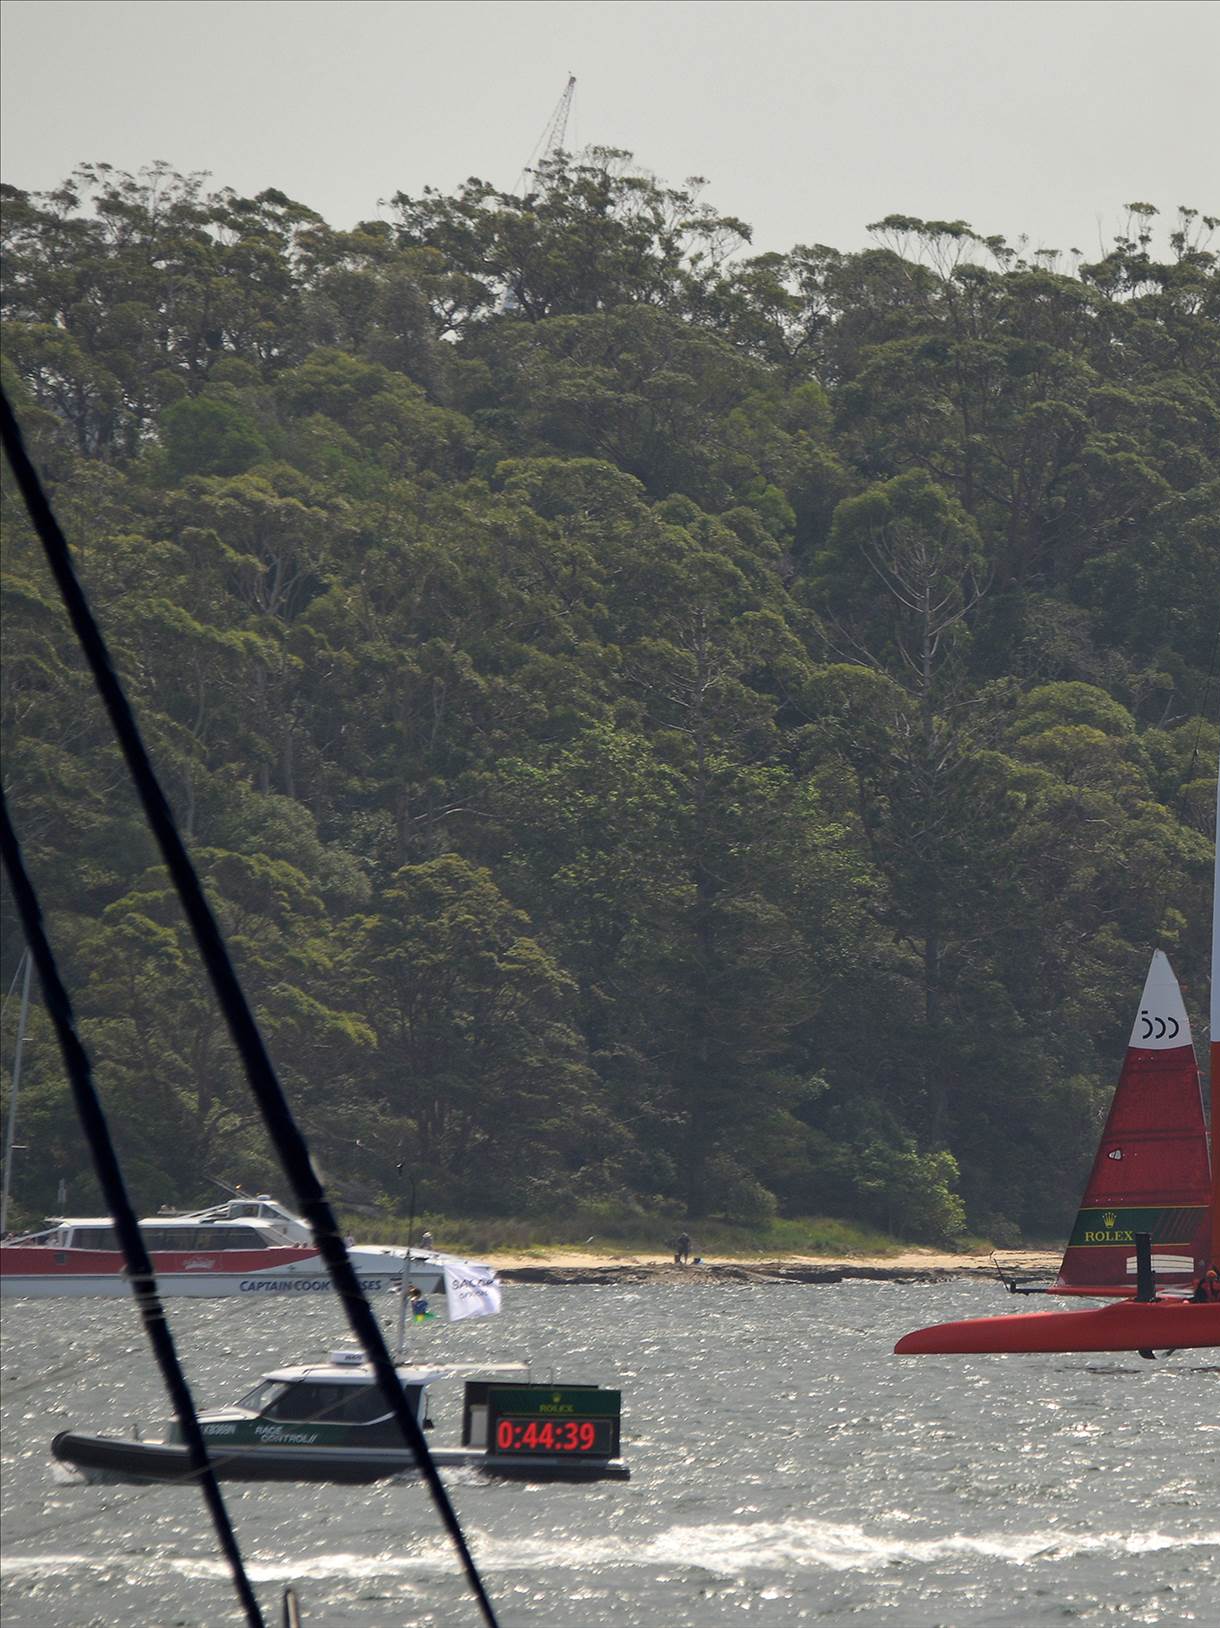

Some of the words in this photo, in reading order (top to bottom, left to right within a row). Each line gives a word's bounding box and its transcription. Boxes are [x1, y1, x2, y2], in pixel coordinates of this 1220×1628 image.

[1085, 1231, 1134, 1242] ROLEX
[240, 1281, 292, 1292] CAPTAIN
[294, 1281, 331, 1291] COOK
[538, 1404, 574, 1413] ROLEX
[497, 1420, 595, 1450] 0:44:39
